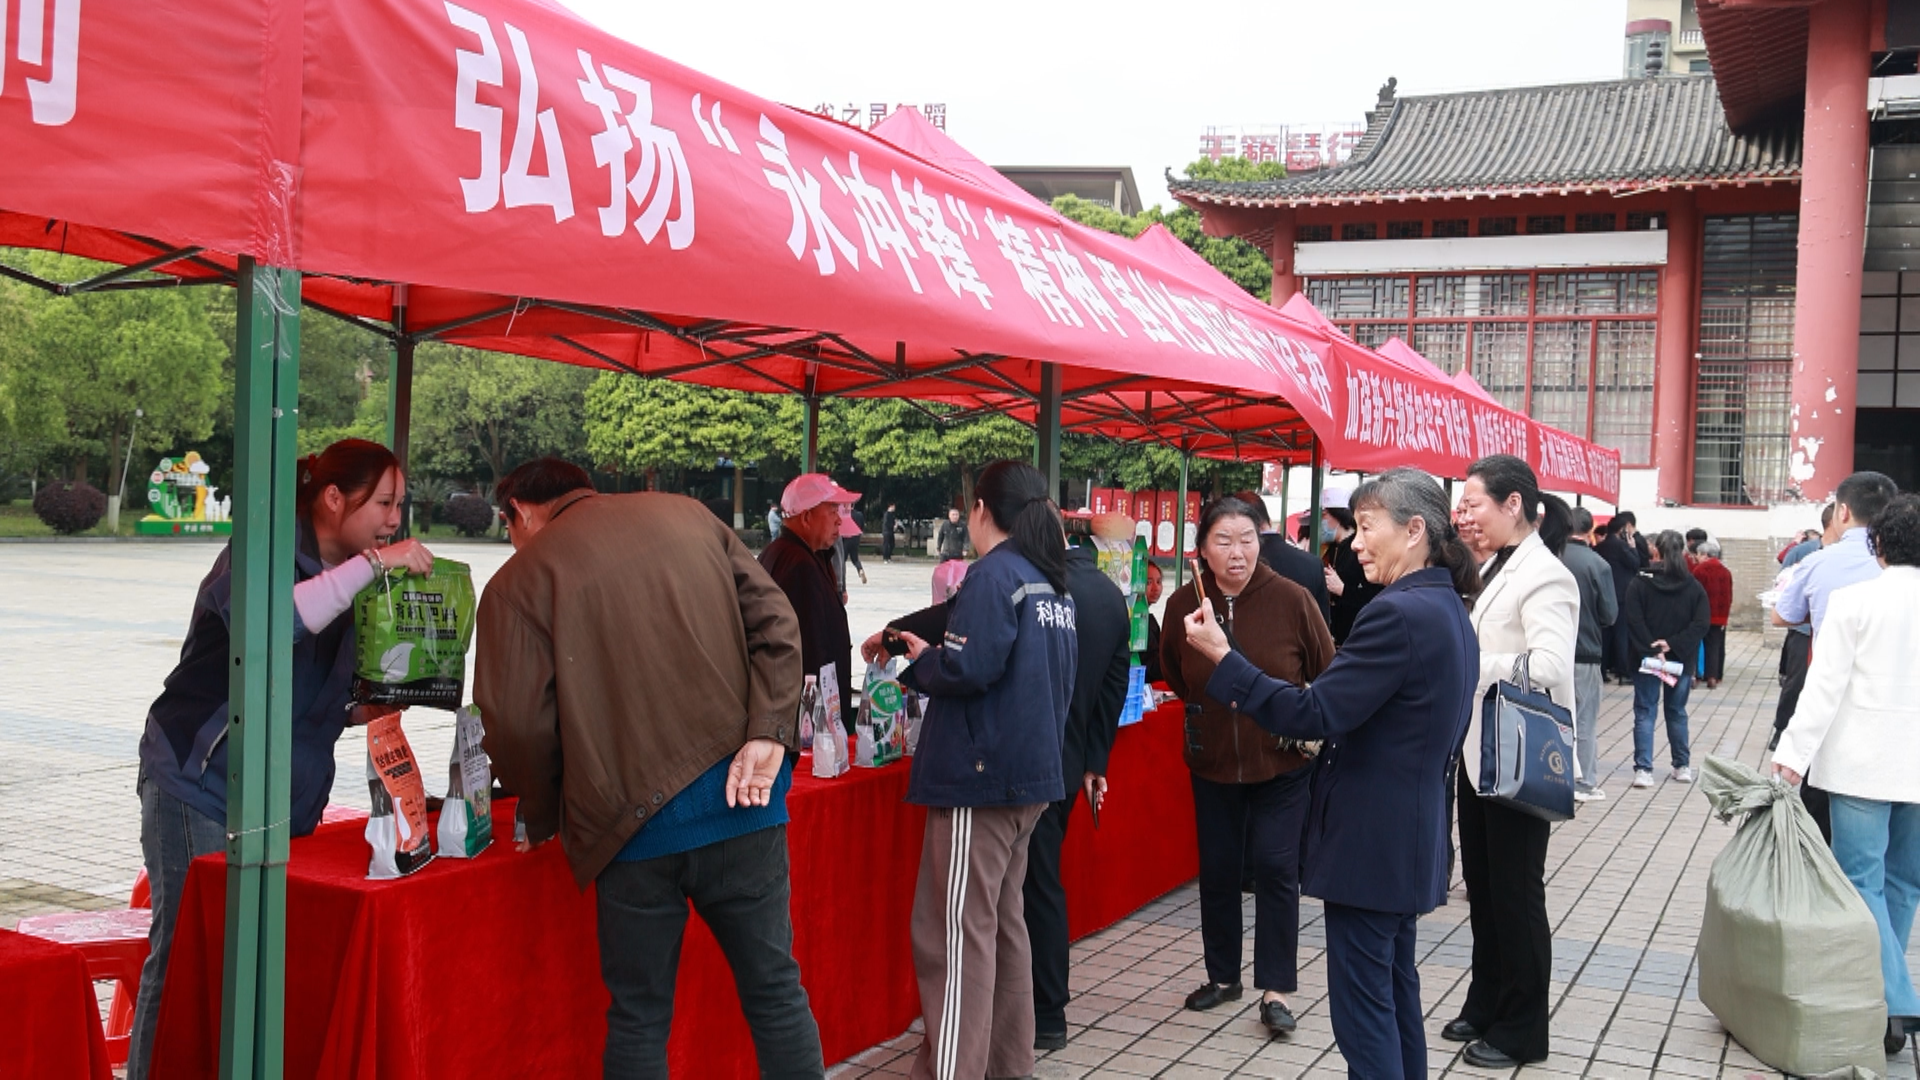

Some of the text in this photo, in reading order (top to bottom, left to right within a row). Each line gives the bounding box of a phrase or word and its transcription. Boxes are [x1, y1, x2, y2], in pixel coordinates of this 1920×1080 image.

[815, 102, 947, 133] 之灵蹈
[1344, 362, 1471, 459] 加强新兴领域知识产权保护
[1036, 600, 1076, 630] 科森农
